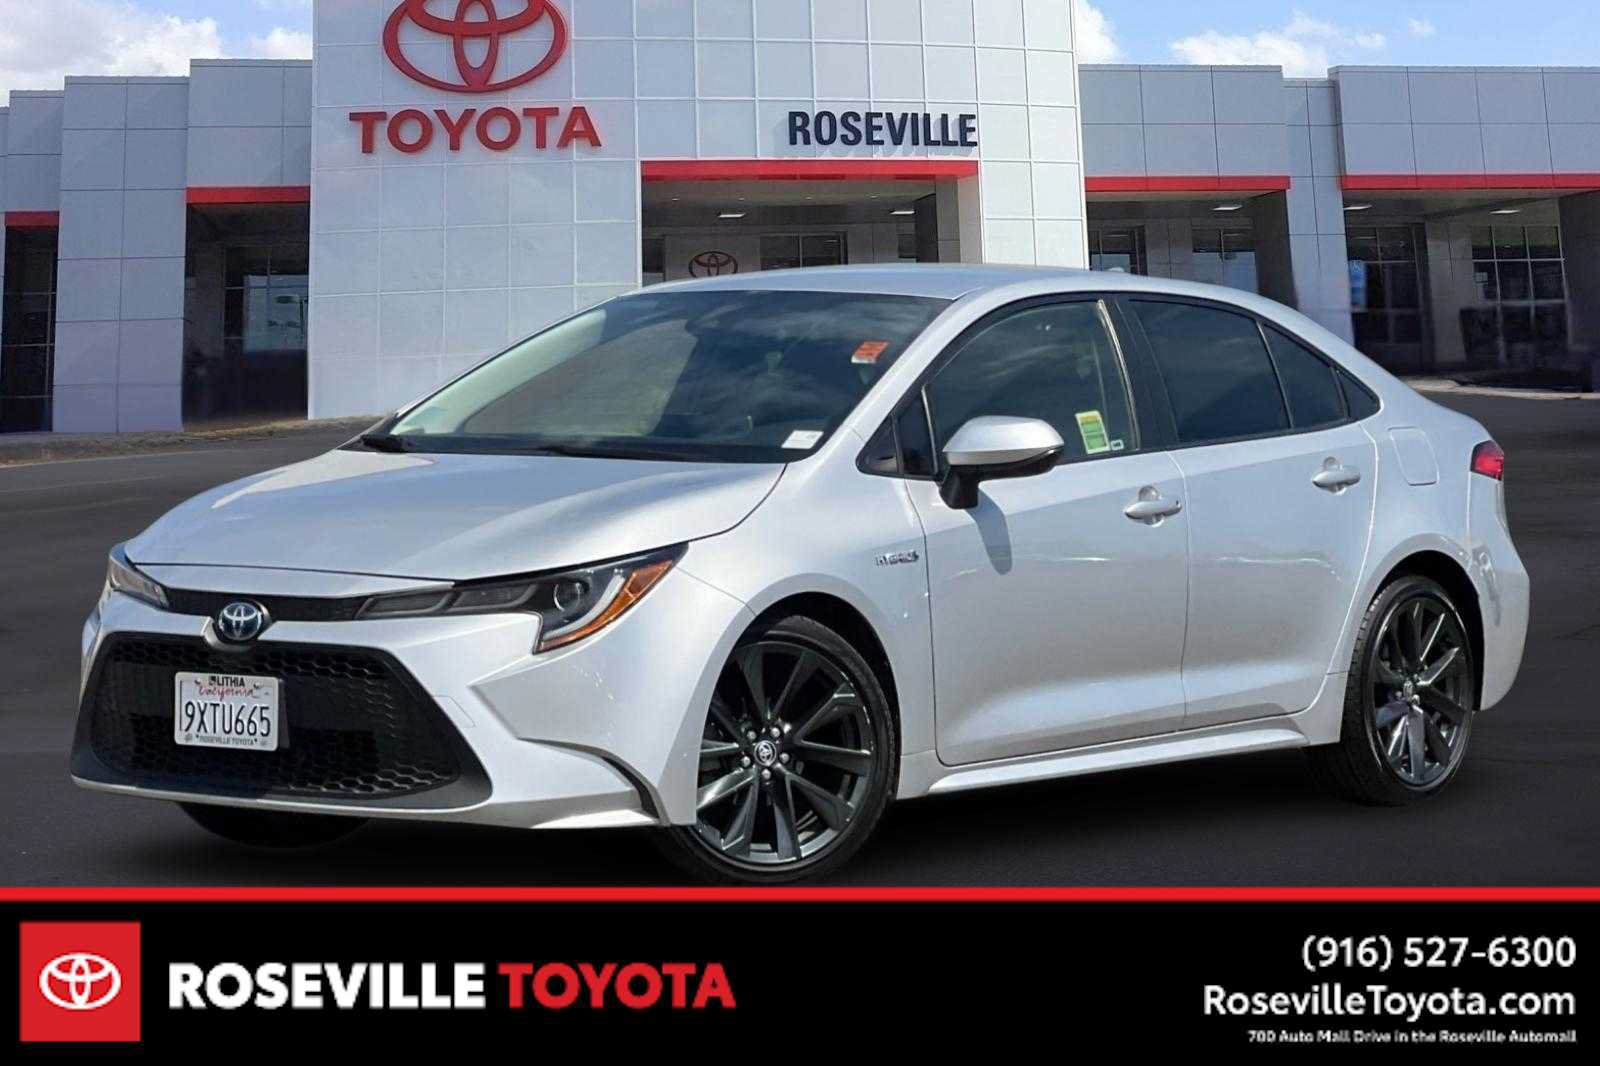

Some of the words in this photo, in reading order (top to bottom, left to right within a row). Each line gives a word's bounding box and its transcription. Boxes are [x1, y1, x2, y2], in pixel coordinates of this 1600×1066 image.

[349, 105, 603, 154] TOYOTA
[788, 111, 978, 148] ROSEVILLE
[217, 676, 245, 687] LITHIA
[184, 701, 271, 737] 9XTU665
